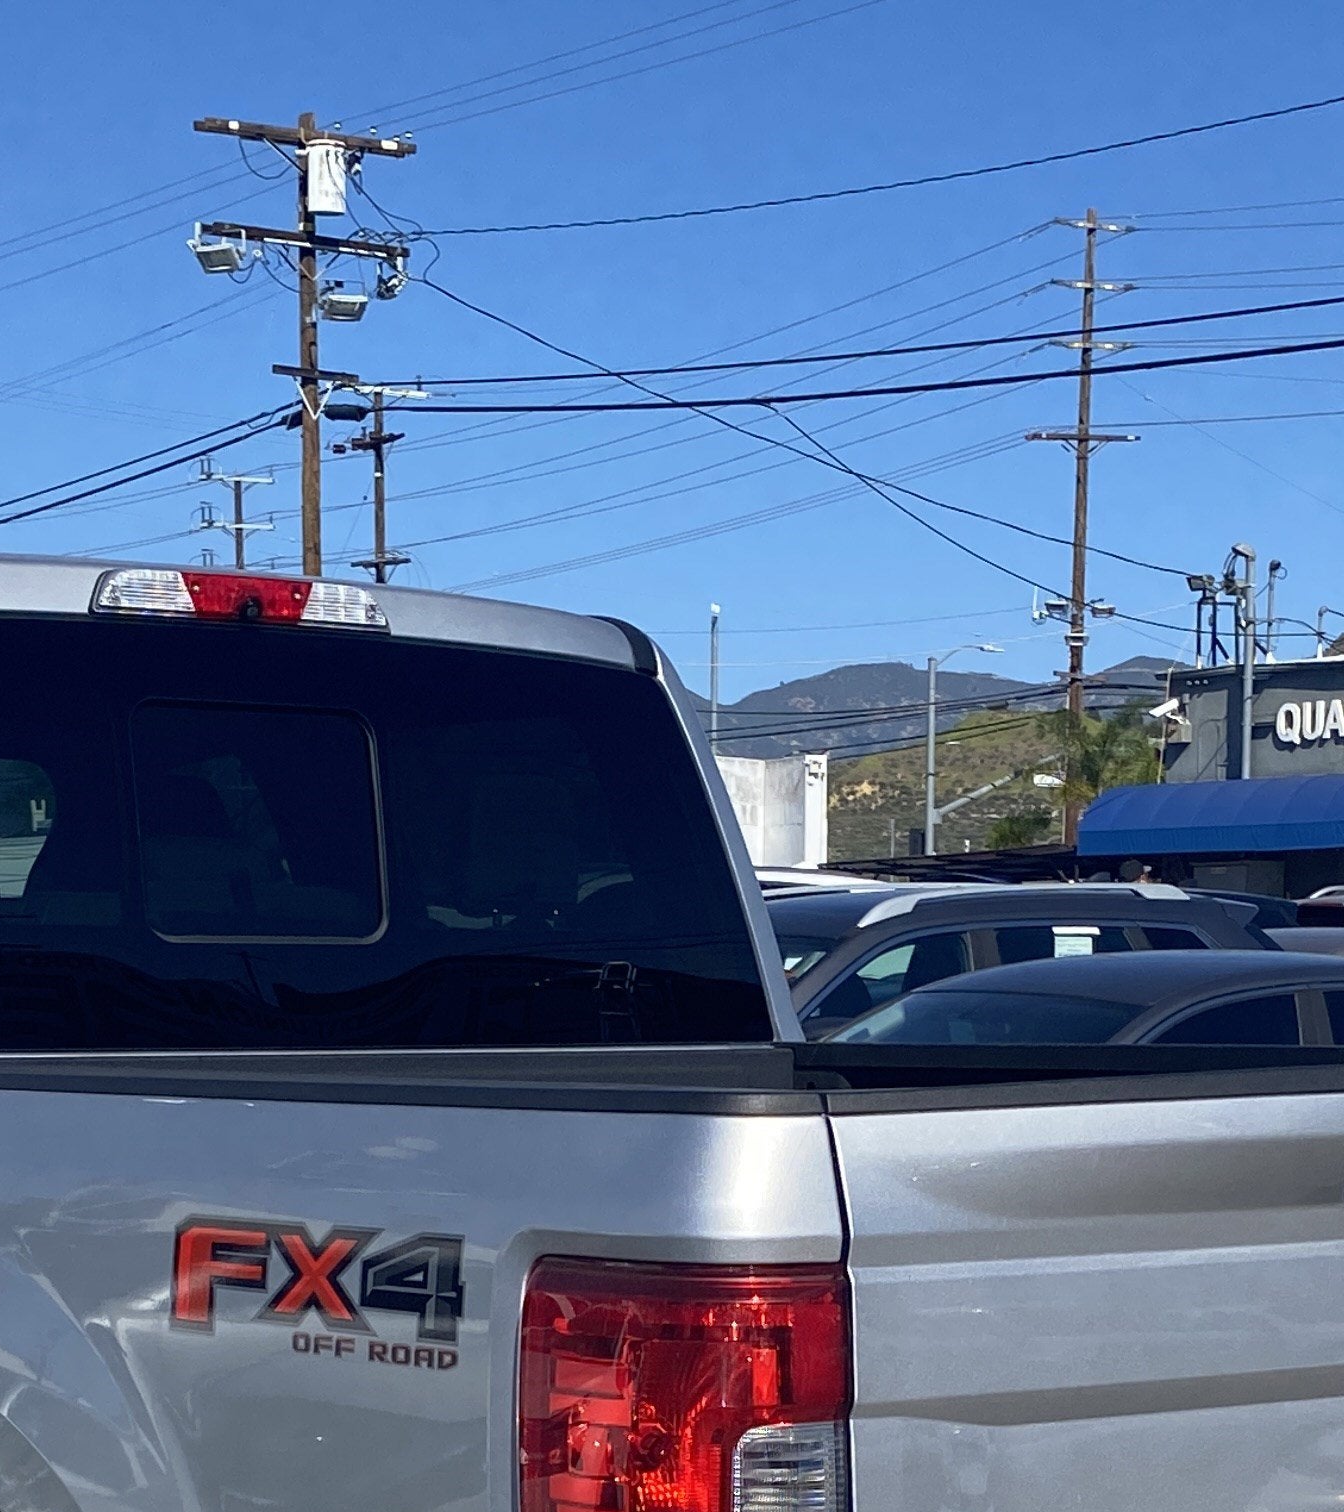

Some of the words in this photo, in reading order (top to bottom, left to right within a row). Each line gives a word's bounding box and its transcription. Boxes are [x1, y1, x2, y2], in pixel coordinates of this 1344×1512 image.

[168, 1213, 466, 1346] FX4
[292, 1331, 356, 1358] OFF
[367, 1340, 458, 1371] ROAD
